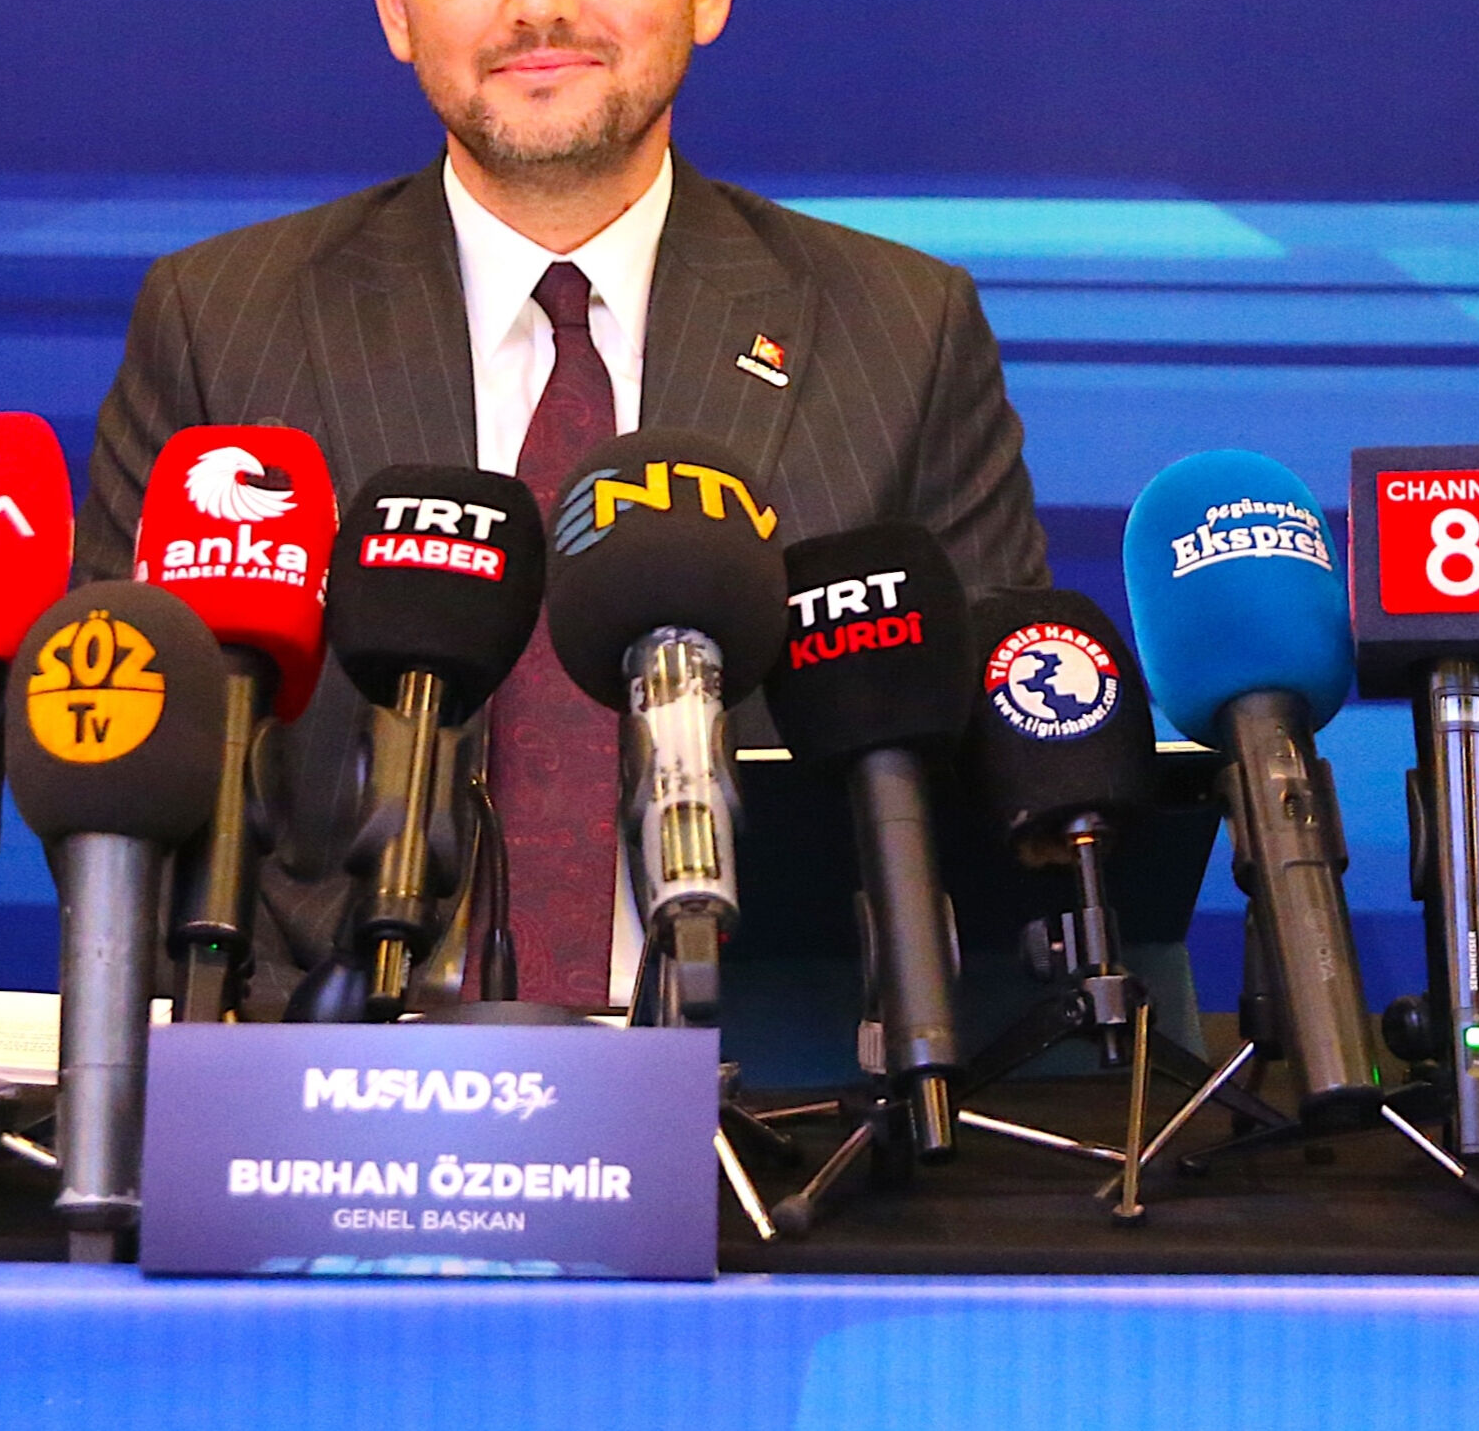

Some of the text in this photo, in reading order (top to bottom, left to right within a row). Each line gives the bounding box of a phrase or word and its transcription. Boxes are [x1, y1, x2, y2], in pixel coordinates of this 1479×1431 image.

[375, 497, 507, 541] TRT
[593, 460, 779, 541] NTV
[163, 523, 309, 573] anka
[366, 537, 500, 576] HABER
[1171, 523, 1331, 569] Ekspres
[161, 564, 227, 582] HABER
[787, 570, 907, 629] TRT
[27, 608, 166, 690] SÖZ
[1044, 625, 1110, 668] HABER
[228, 1154, 632, 1201] BURHAN ÖZDEMİR
[333, 1208, 526, 1236] GENEL BAŞKAN
